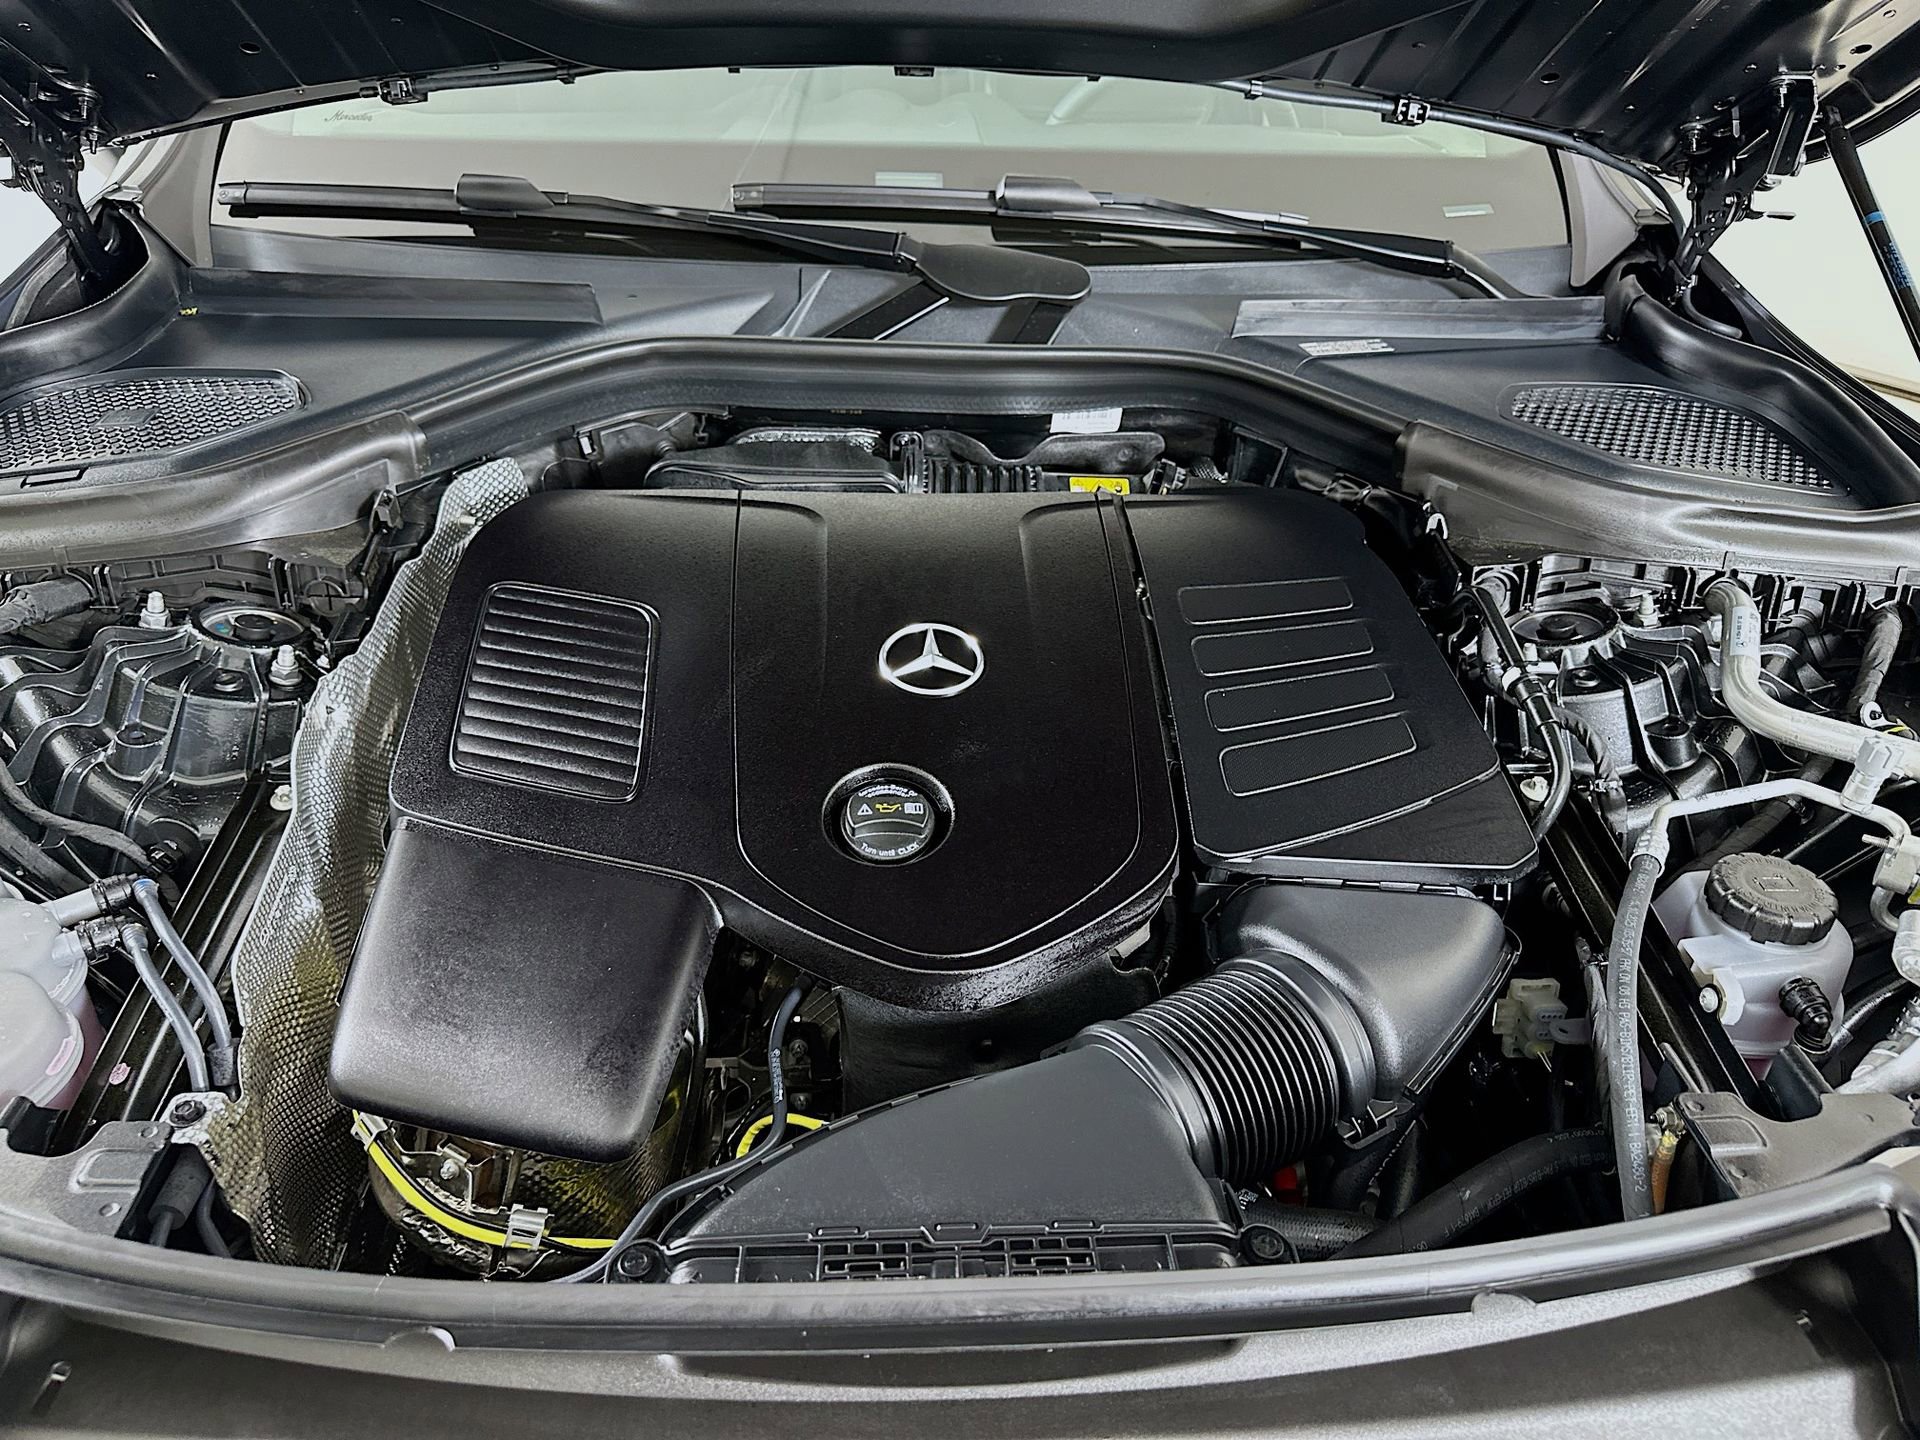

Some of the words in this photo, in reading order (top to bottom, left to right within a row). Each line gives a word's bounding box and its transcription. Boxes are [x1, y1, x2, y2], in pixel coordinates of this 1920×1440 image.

[861, 842, 877, 855] Turn
[878, 849, 896, 857] until
[897, 841, 920, 856] CLICK
